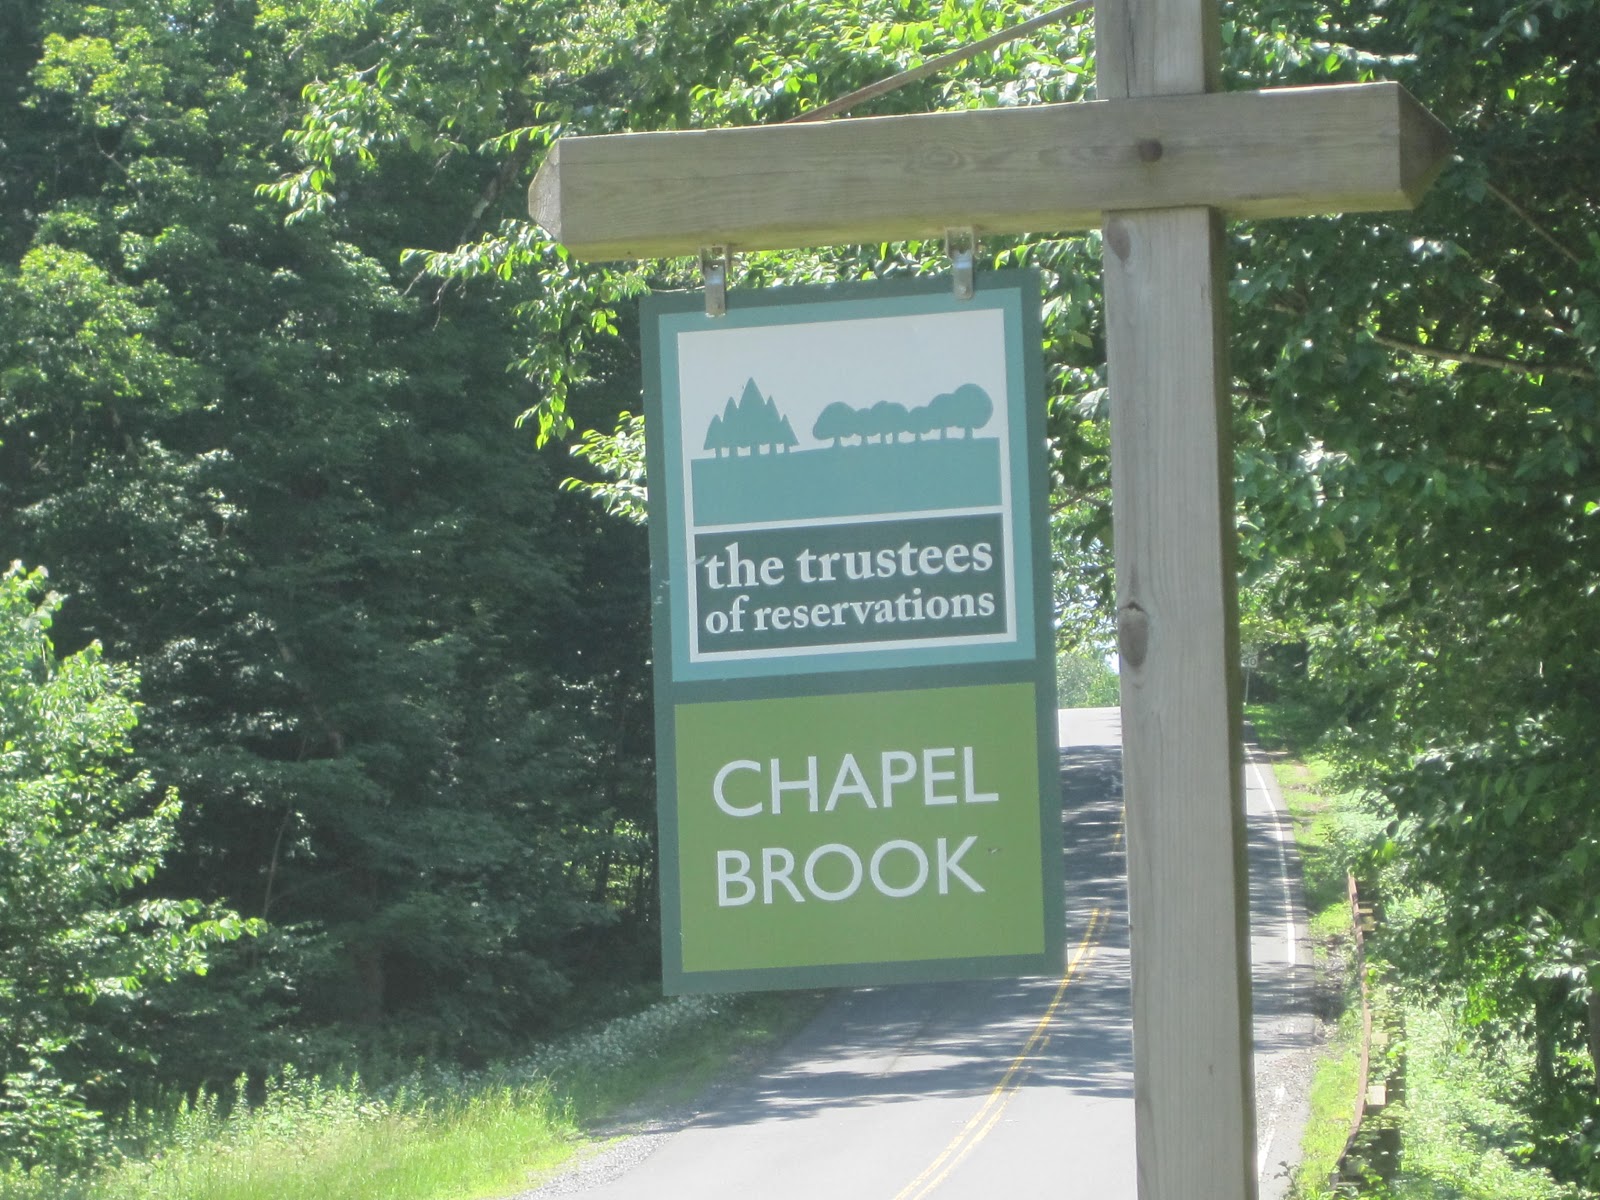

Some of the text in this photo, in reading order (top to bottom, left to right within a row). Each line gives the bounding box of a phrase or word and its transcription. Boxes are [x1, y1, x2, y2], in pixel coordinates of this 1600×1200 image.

[704, 541, 993, 590] the trustees
[705, 588, 995, 634] of reservations
[712, 746, 1000, 817] CHAPEL
[716, 835, 986, 907] BROOK
